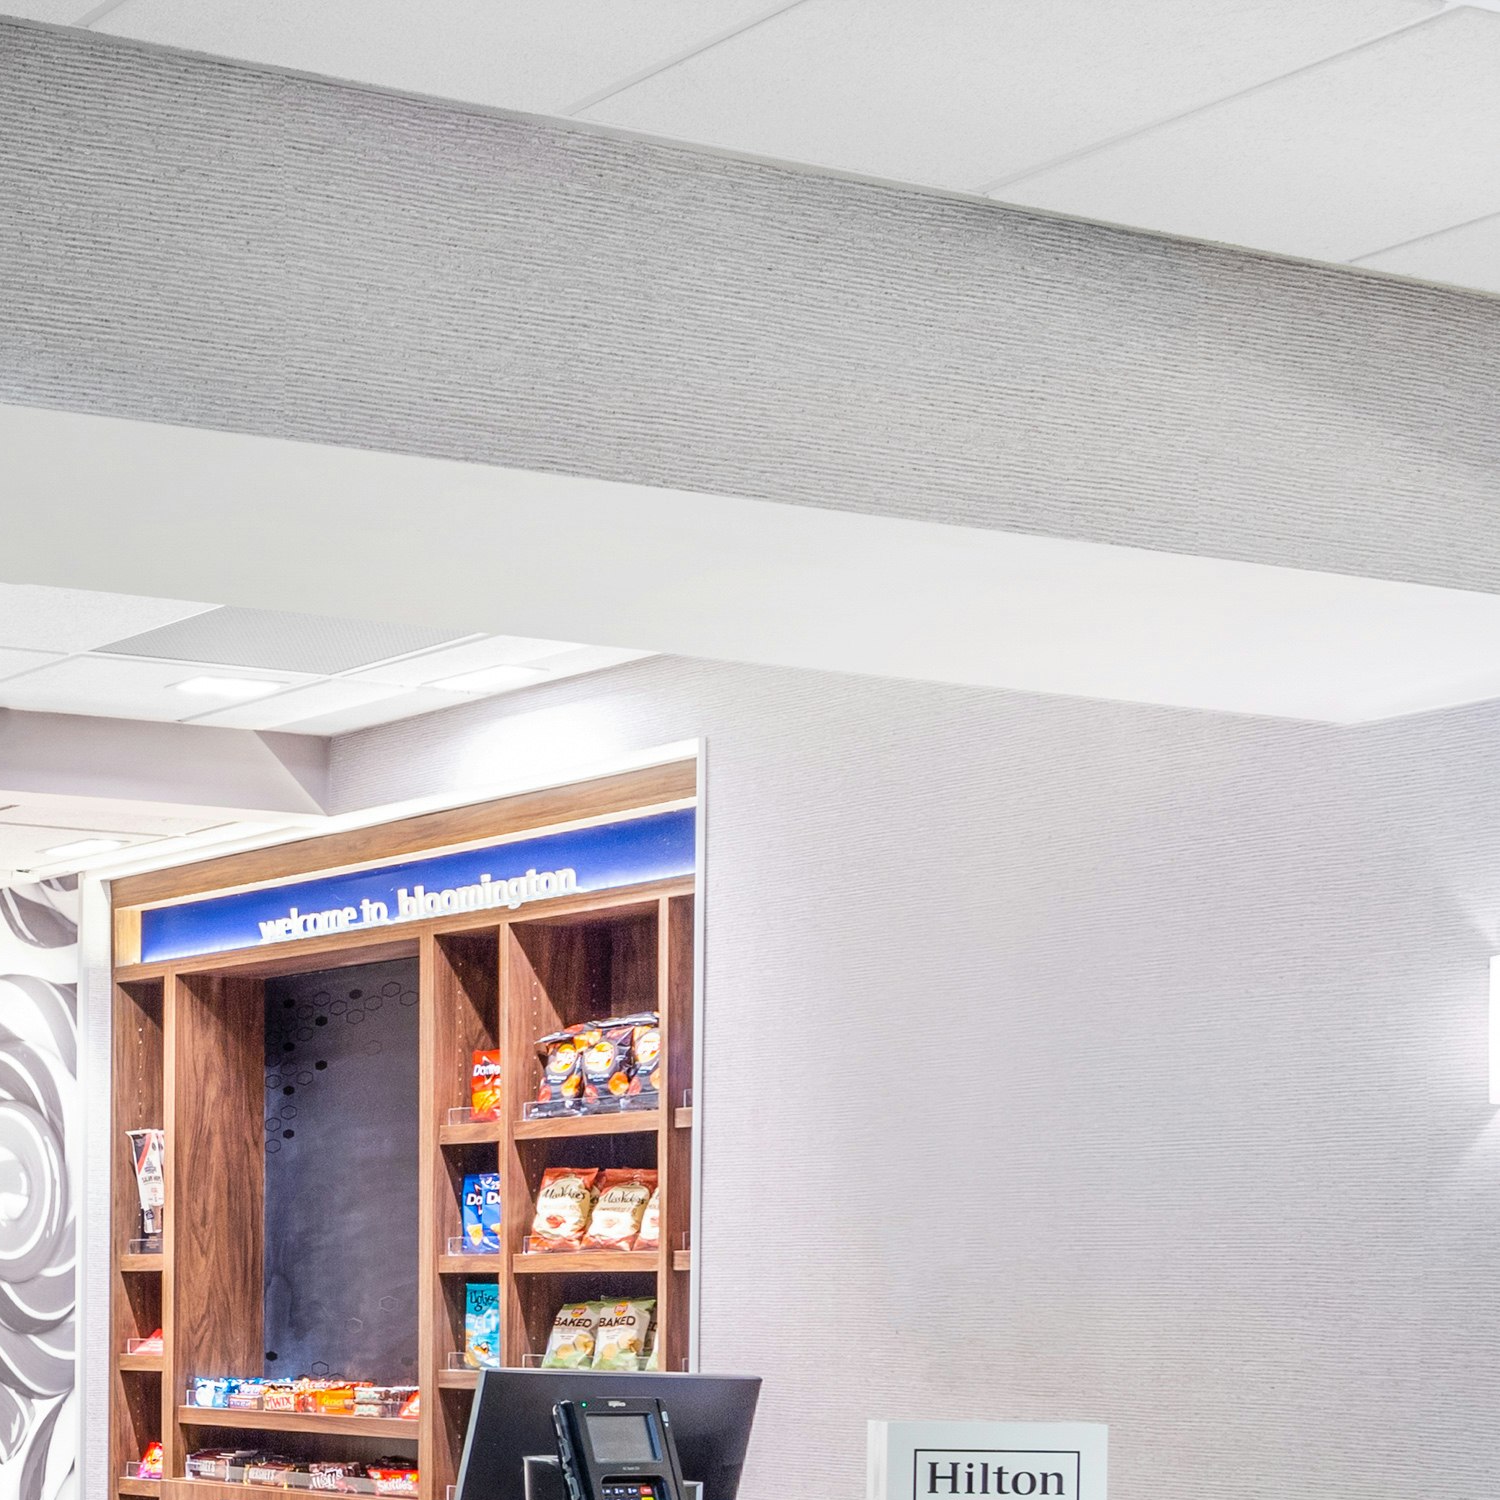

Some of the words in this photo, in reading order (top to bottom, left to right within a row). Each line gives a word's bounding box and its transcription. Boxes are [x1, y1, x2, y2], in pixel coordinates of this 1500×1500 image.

[258, 905, 357, 941] welcome
[360, 898, 388, 923] to
[397, 867, 577, 917] bloomington
[554, 1317, 593, 1328] BAKED
[599, 1315, 636, 1328] BAKED
[267, 1395, 292, 1410] TWIX
[377, 1478, 414, 1492] Skittles
[927, 1461, 1066, 1495] Hilton
